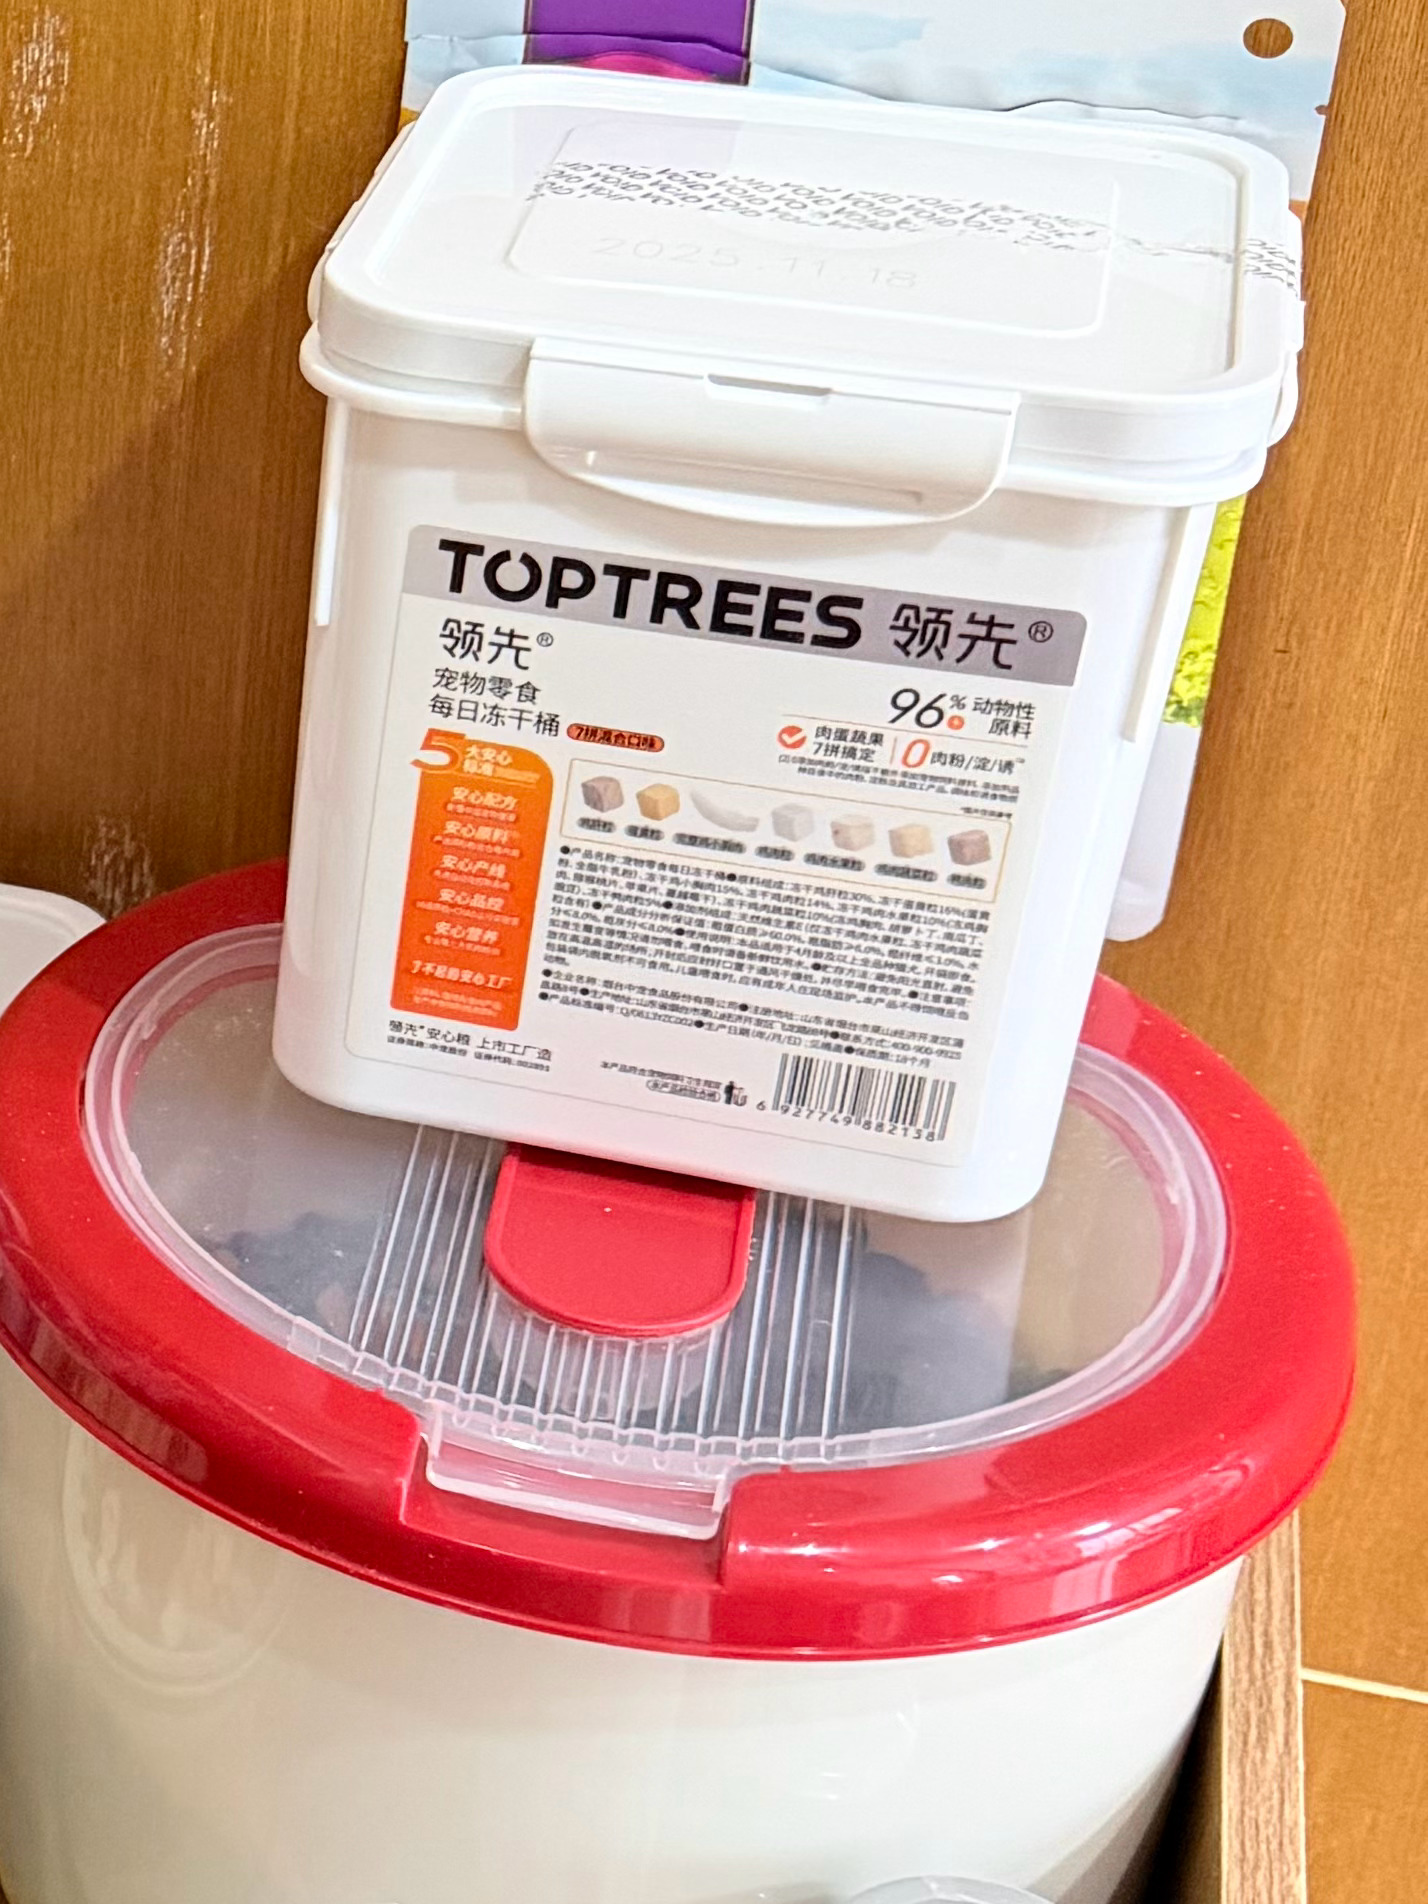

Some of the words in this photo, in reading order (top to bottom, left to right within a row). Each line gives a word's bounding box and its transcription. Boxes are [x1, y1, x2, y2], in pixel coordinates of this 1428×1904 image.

[439, 539, 863, 650] TOPTREES
[432, 667, 542, 706] 宠物零食
[429, 693, 560, 737] 每日冻干桶
[972, 696, 1036, 721] 动物性
[814, 725, 884, 747] 肉蛋蔬果
[989, 718, 1032, 740] 原料
[410, 728, 466, 774] 5
[465, 744, 513, 766] 大安心
[812, 741, 875, 763] 7拼搞定
